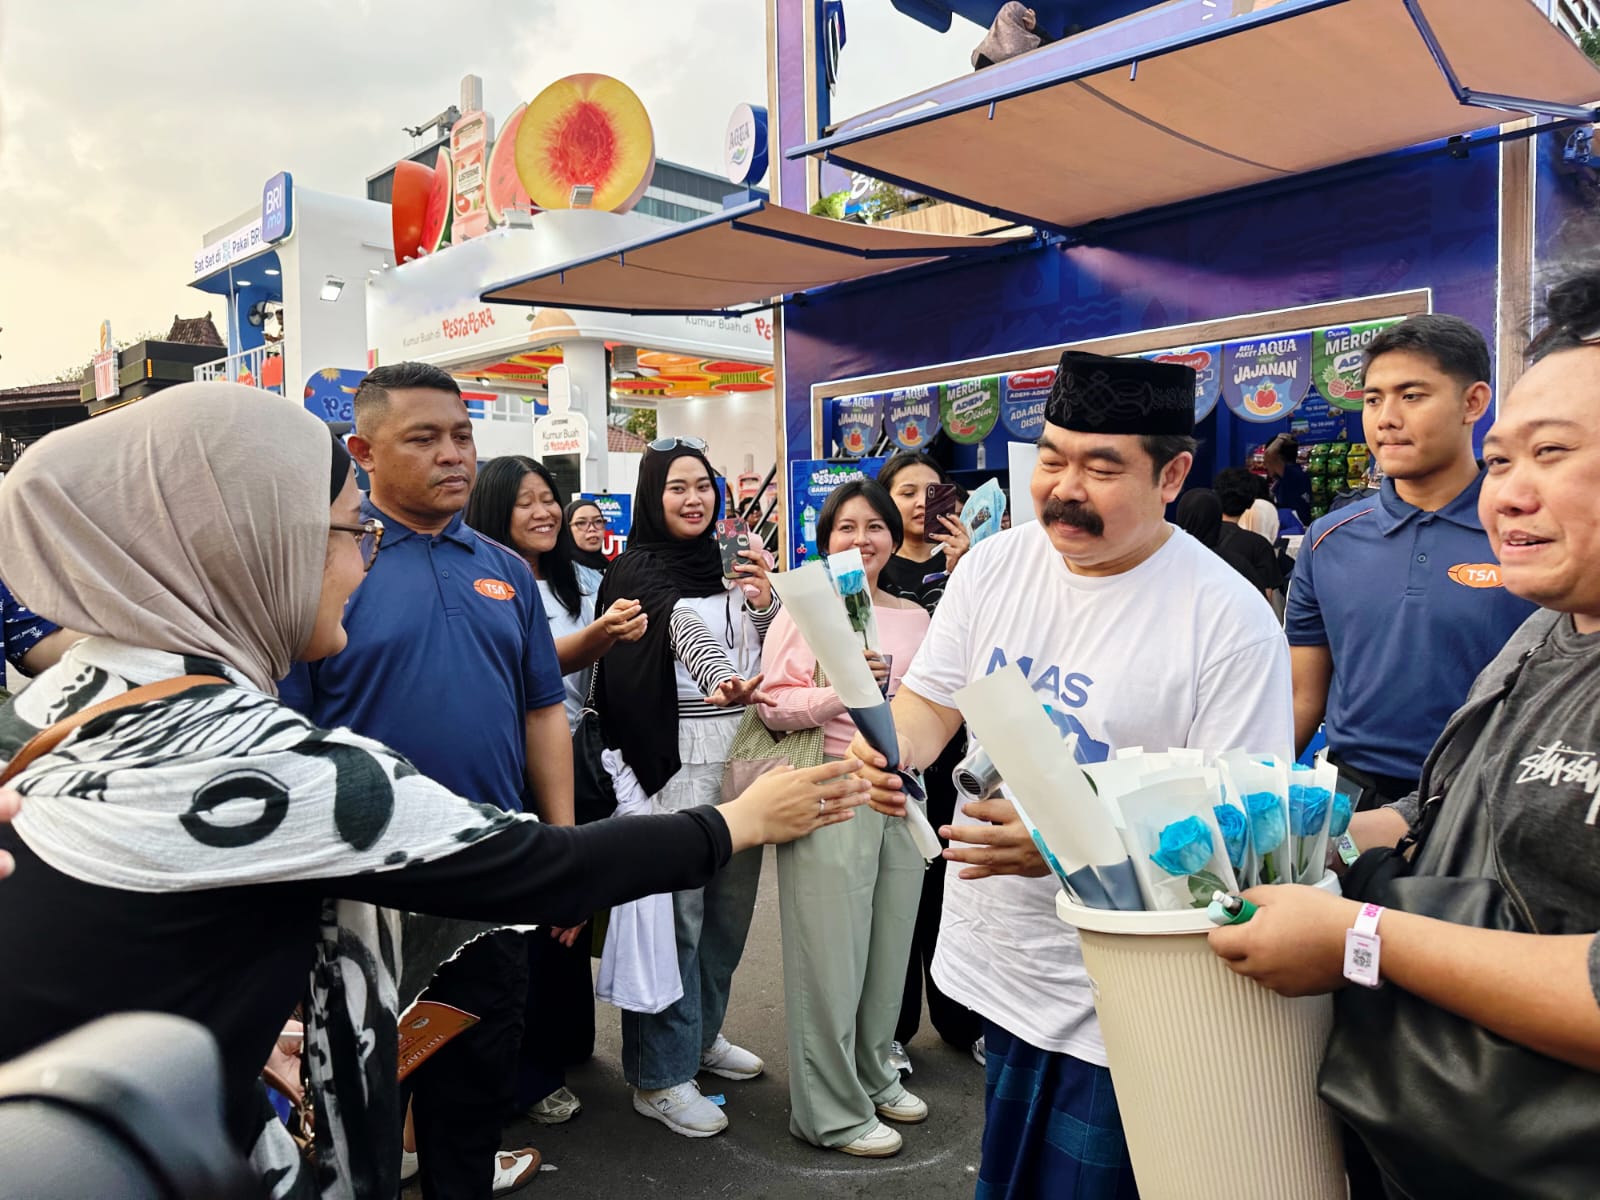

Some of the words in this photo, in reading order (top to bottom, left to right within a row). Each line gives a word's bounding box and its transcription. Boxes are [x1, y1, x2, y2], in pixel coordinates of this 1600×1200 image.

[266, 184, 282, 215] BRI
[194, 258, 204, 274] Sat
[205, 254, 215, 269] Set
[232, 234, 250, 255] Pakai
[685, 316, 716, 329] Kumur
[718, 318, 741, 332] Buah
[743, 323, 752, 333] di
[1258, 339, 1297, 356] AQUA
[1234, 360, 1297, 385] JAJANAN
[947, 379, 982, 401] MERCH
[853, 398, 874, 409] AQUA
[891, 403, 931, 422] JAJANAN
[838, 413, 874, 428] JAJANAN
[1011, 409, 1027, 421] ADA
